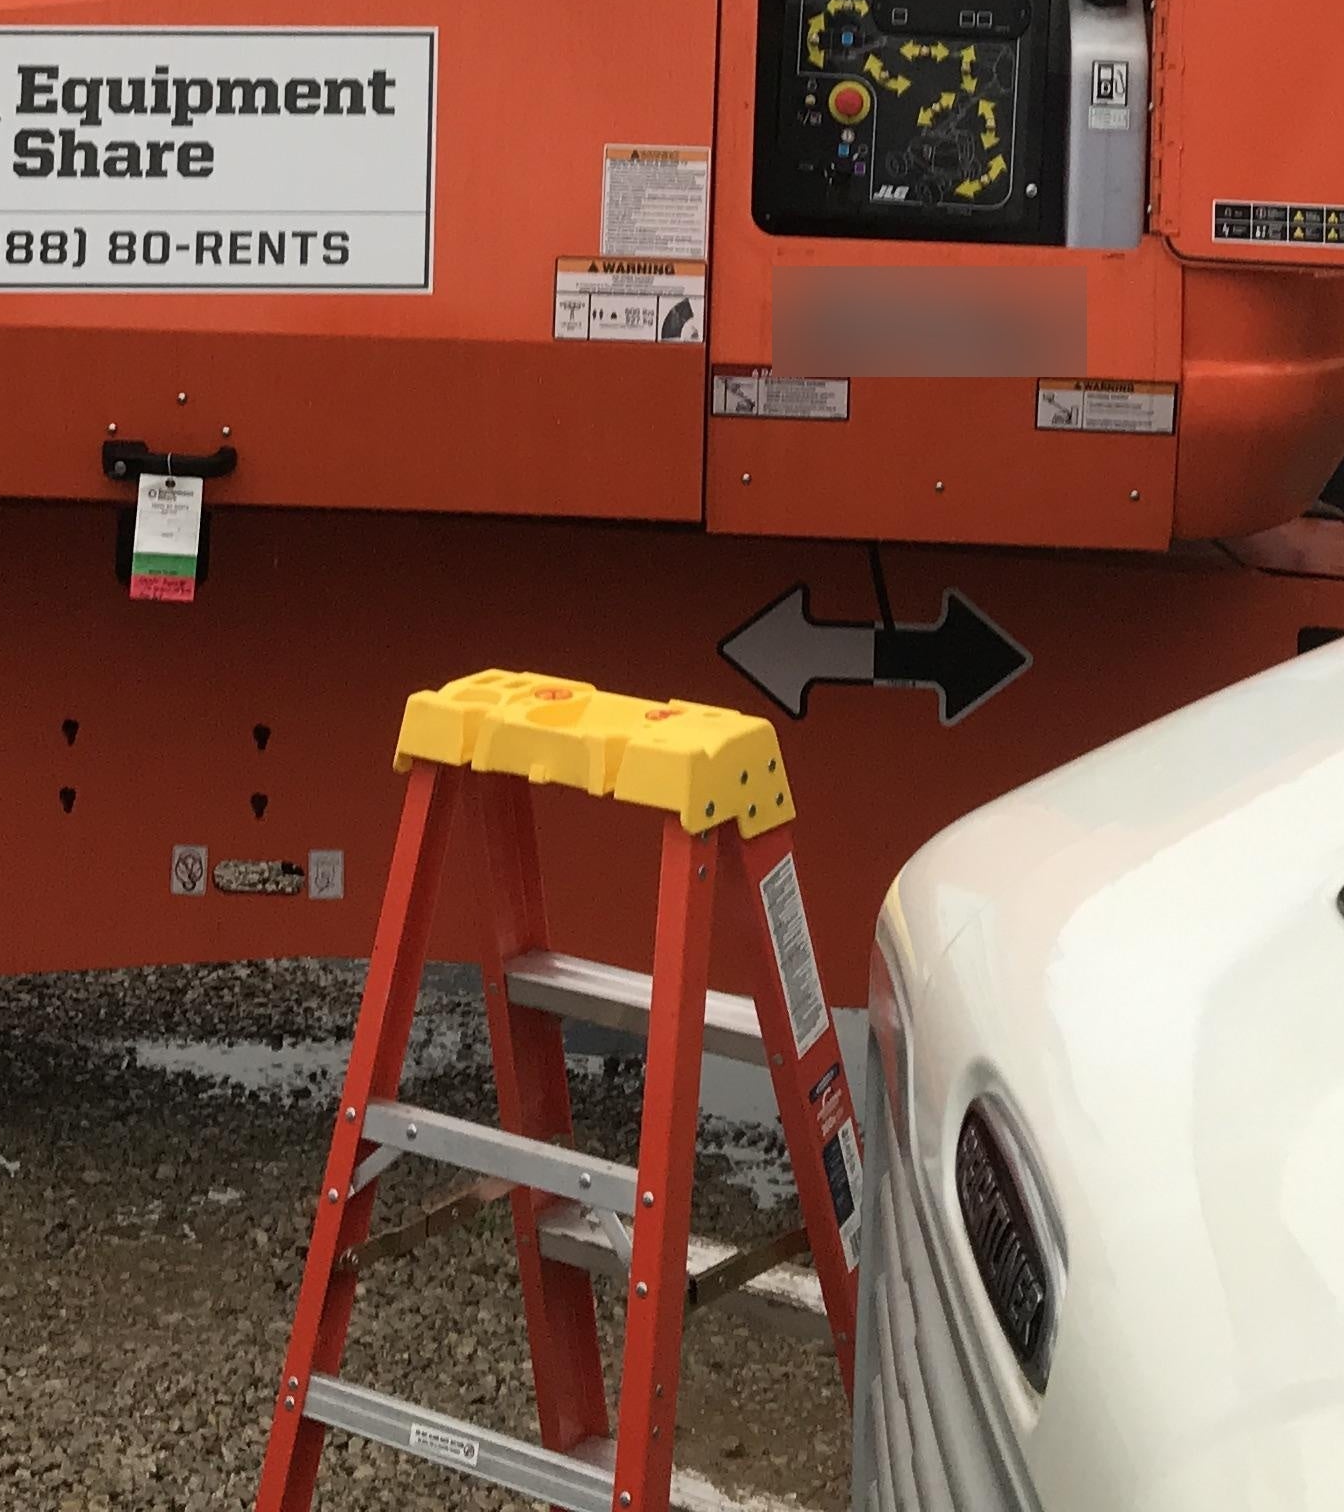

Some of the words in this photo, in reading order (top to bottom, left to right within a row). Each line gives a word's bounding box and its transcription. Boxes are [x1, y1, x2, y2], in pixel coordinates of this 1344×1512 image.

[15, 64, 396, 127] Equipment
[12, 127, 215, 178] Share
[872, 185, 909, 201] JLG
[108, 229, 351, 266] 80-RENTS
[602, 261, 676, 276] WARNING
